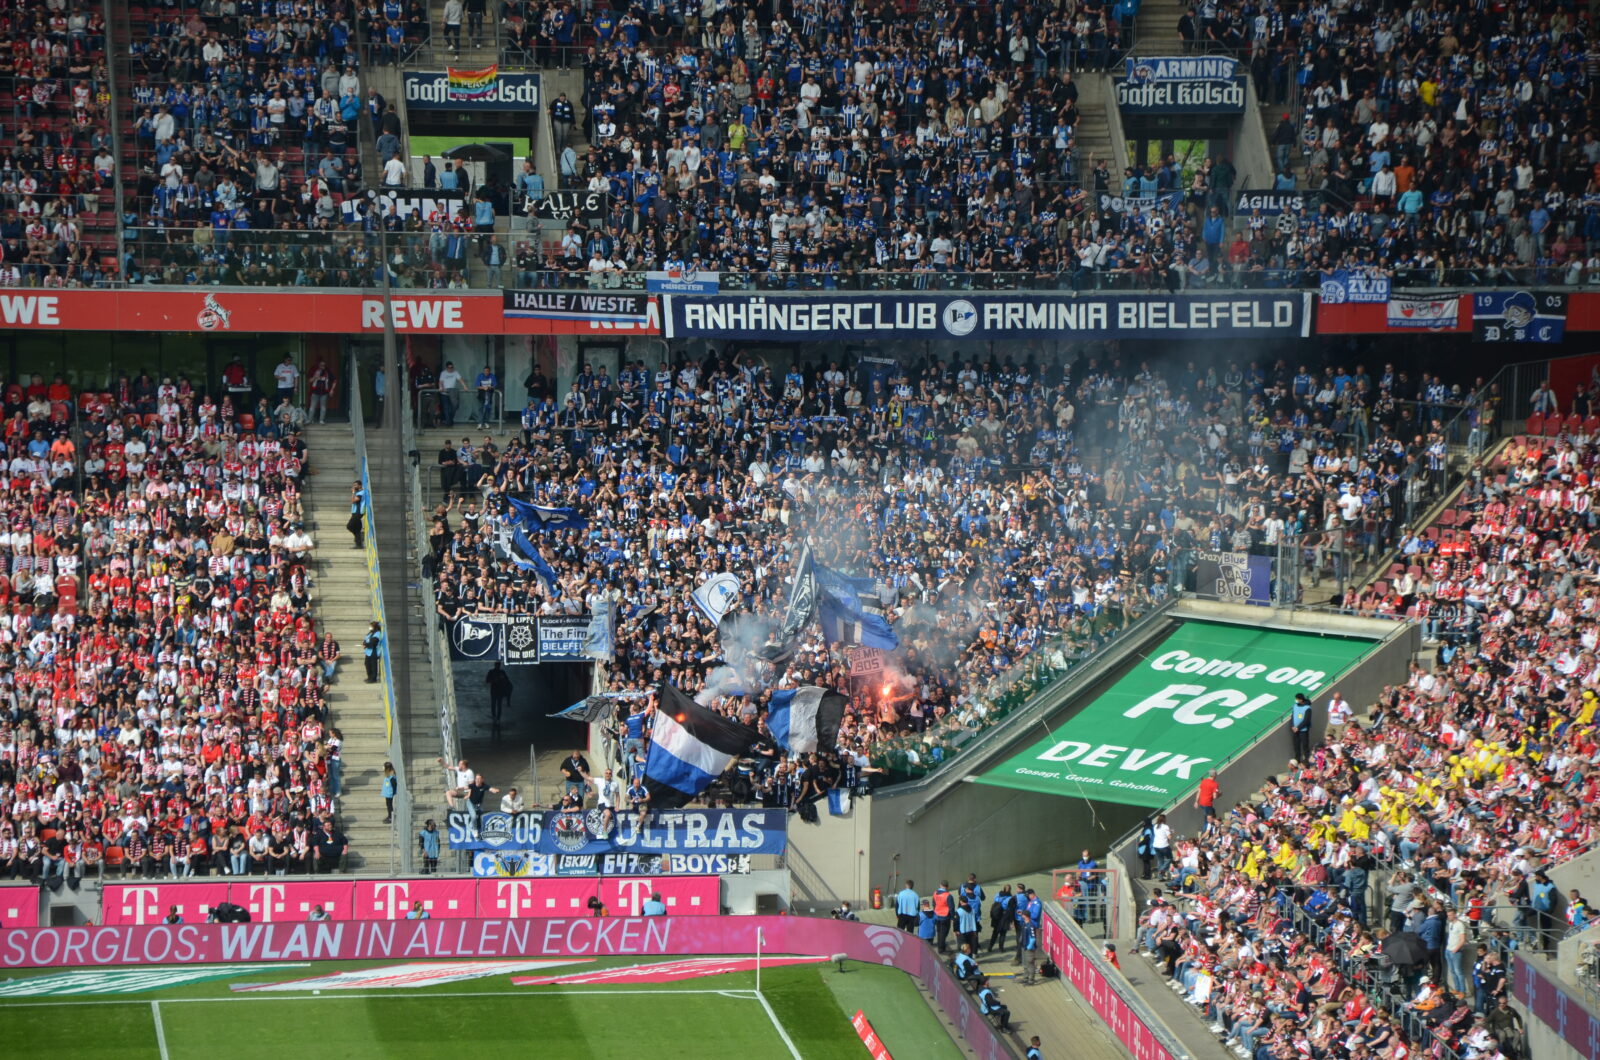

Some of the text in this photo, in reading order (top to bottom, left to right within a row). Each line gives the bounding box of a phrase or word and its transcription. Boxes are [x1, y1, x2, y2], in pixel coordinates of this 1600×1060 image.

[1156, 60, 1233, 78] ARMINIS
[406, 77, 468, 103] Gaff
[660, 283, 704, 291] MÜNSTER
[361, 300, 465, 329] REWE
[514, 293, 567, 310] HALLE
[580, 296, 638, 313] WESTF.
[684, 297, 937, 331] ANHÄNGERCLUB
[983, 302, 1108, 330] ARMINIA
[1117, 301, 1293, 329] BIELEFELD
[1478, 296, 1562, 307] 19 05
[1199, 551, 1245, 564] Crazy Blue
[542, 628, 563, 639] The
[542, 641, 584, 651] BIELEFEL
[1150, 650, 1327, 691] Come on,
[1123, 684, 1278, 730] FC!
[1036, 740, 1212, 780] DEVK
[1015, 767, 1169, 794] Gesagt. Getan. Geholfen.
[515, 812, 542, 844] 05
[615, 812, 765, 849] ULTRAS
[603, 854, 638, 873] 647
[672, 854, 727, 873] BOYS
[4, 918, 671, 965] SORGLOS: WLAN IN ALLEN ECKEN
